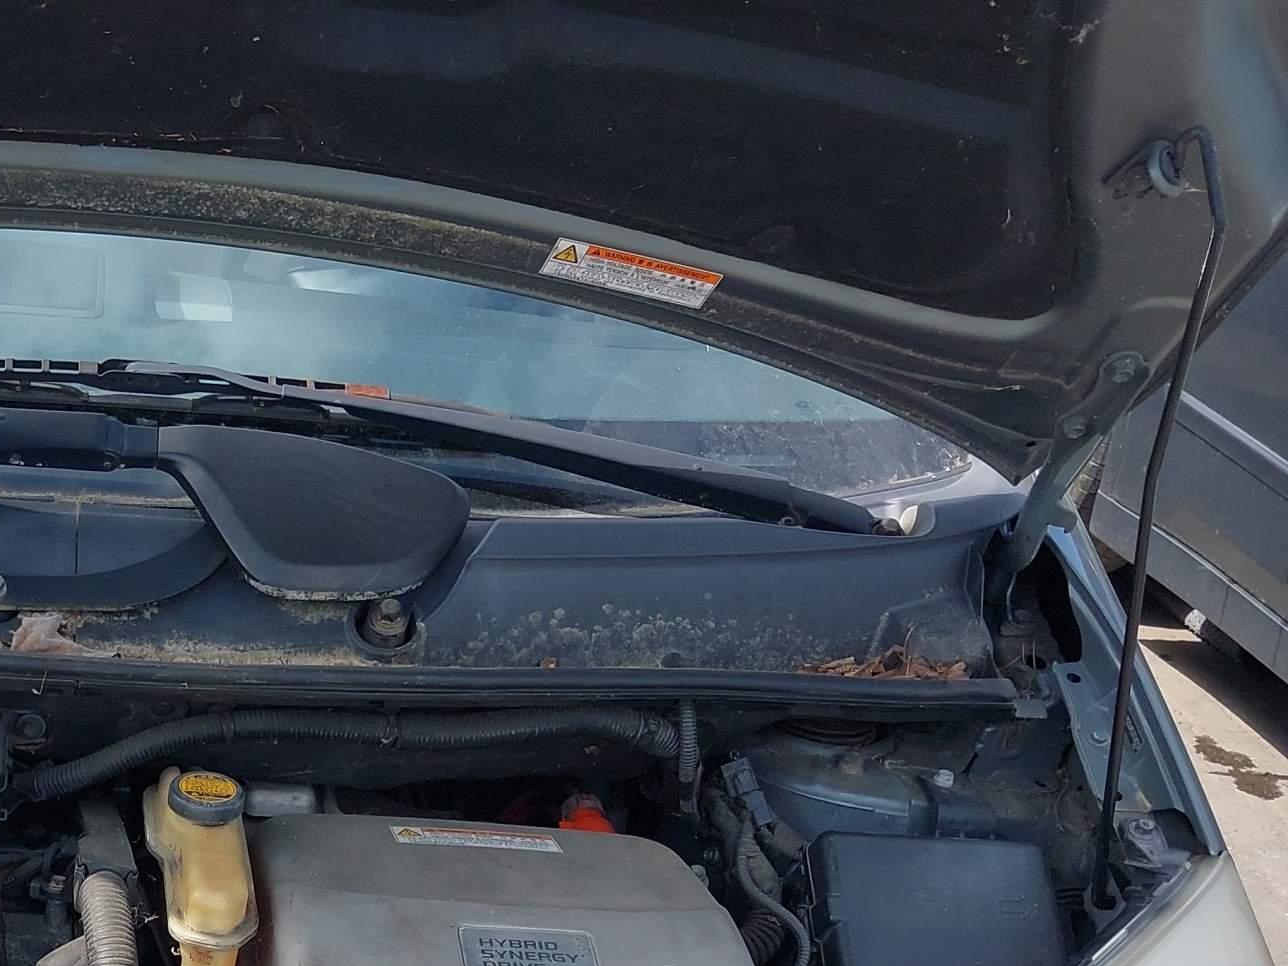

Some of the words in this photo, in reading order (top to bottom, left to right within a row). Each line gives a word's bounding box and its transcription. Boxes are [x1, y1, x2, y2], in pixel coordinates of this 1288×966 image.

[604, 252, 635, 264] WARNING
[655, 263, 711, 281] AVERTISSEMENT
[479, 938, 558, 951] HYBRID
[481, 950, 579, 963] SYNERGY
